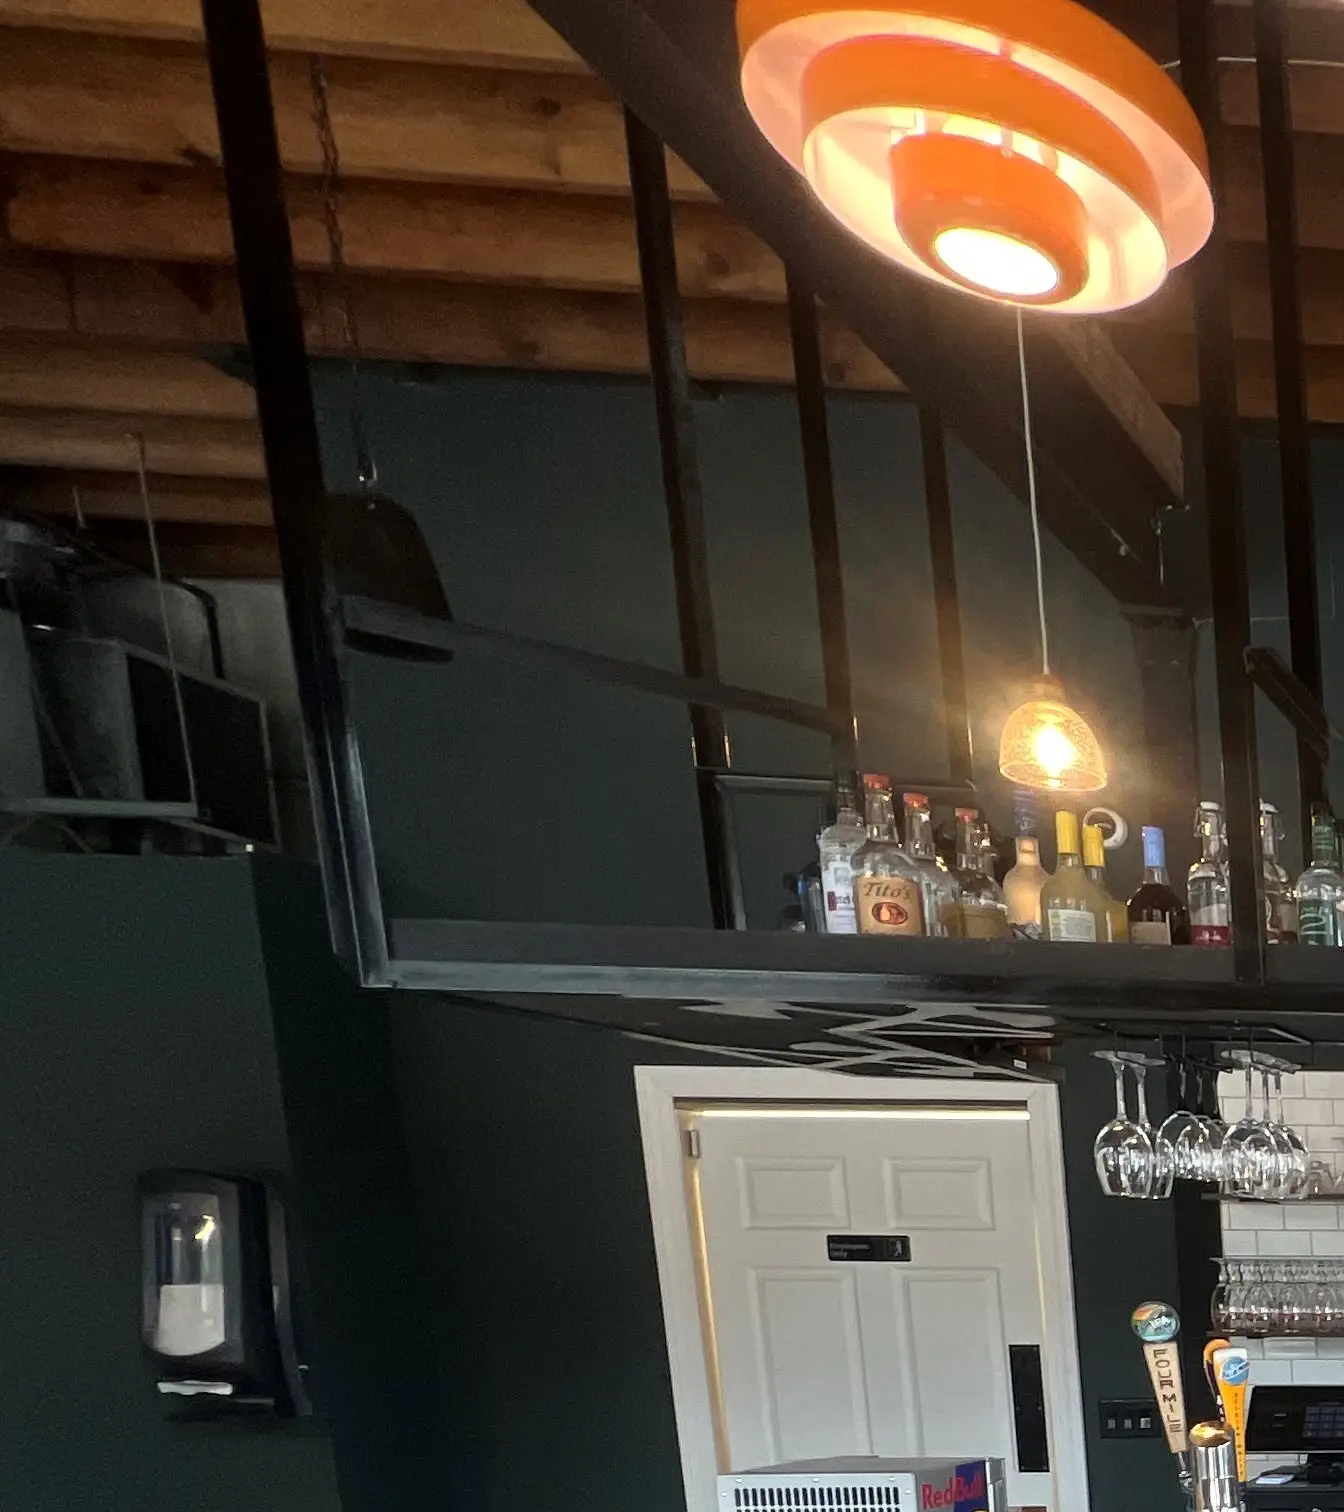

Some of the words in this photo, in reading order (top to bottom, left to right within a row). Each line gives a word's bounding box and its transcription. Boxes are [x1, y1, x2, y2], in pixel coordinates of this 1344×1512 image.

[864, 881, 912, 899] Tito's
[1152, 1348, 1175, 1391] FOUR
[1162, 1393, 1183, 1434] MILE
[921, 1477, 953, 1511] Red
[954, 1469, 984, 1503] Bull
